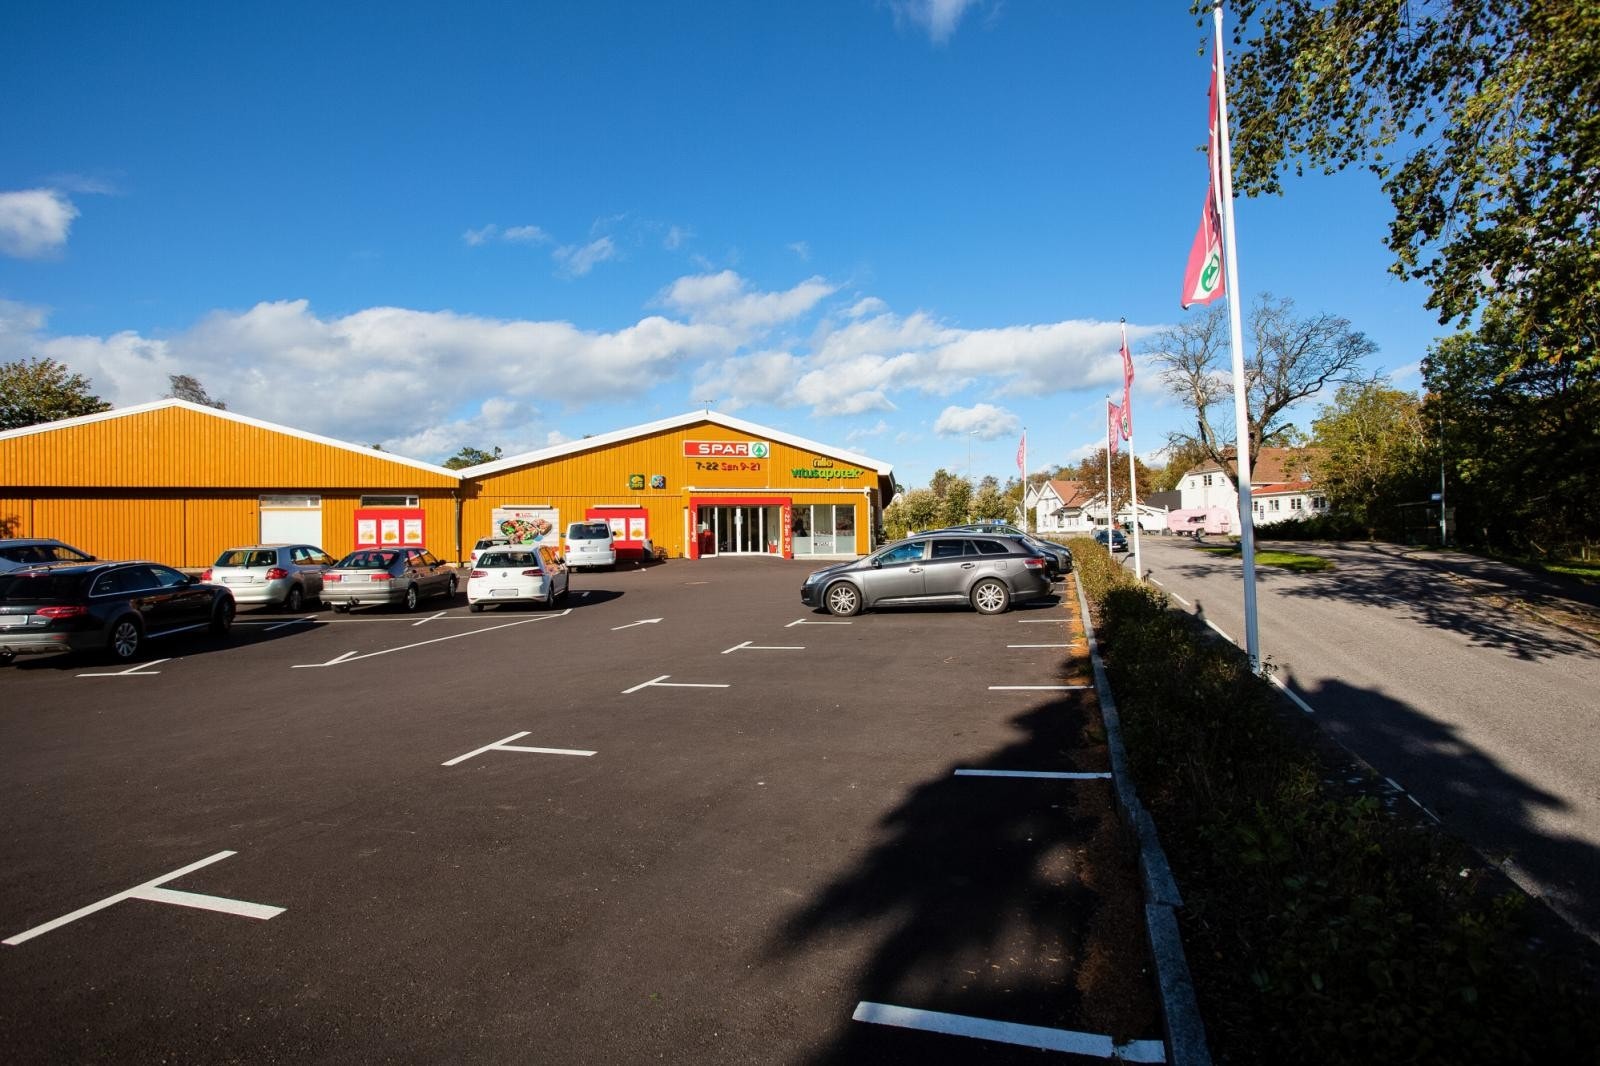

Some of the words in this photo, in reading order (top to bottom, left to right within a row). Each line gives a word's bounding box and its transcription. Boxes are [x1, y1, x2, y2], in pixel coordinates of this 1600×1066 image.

[698, 443, 748, 455] SPAR
[696, 462, 719, 471] 7-22
[740, 462, 761, 471] 9-21
